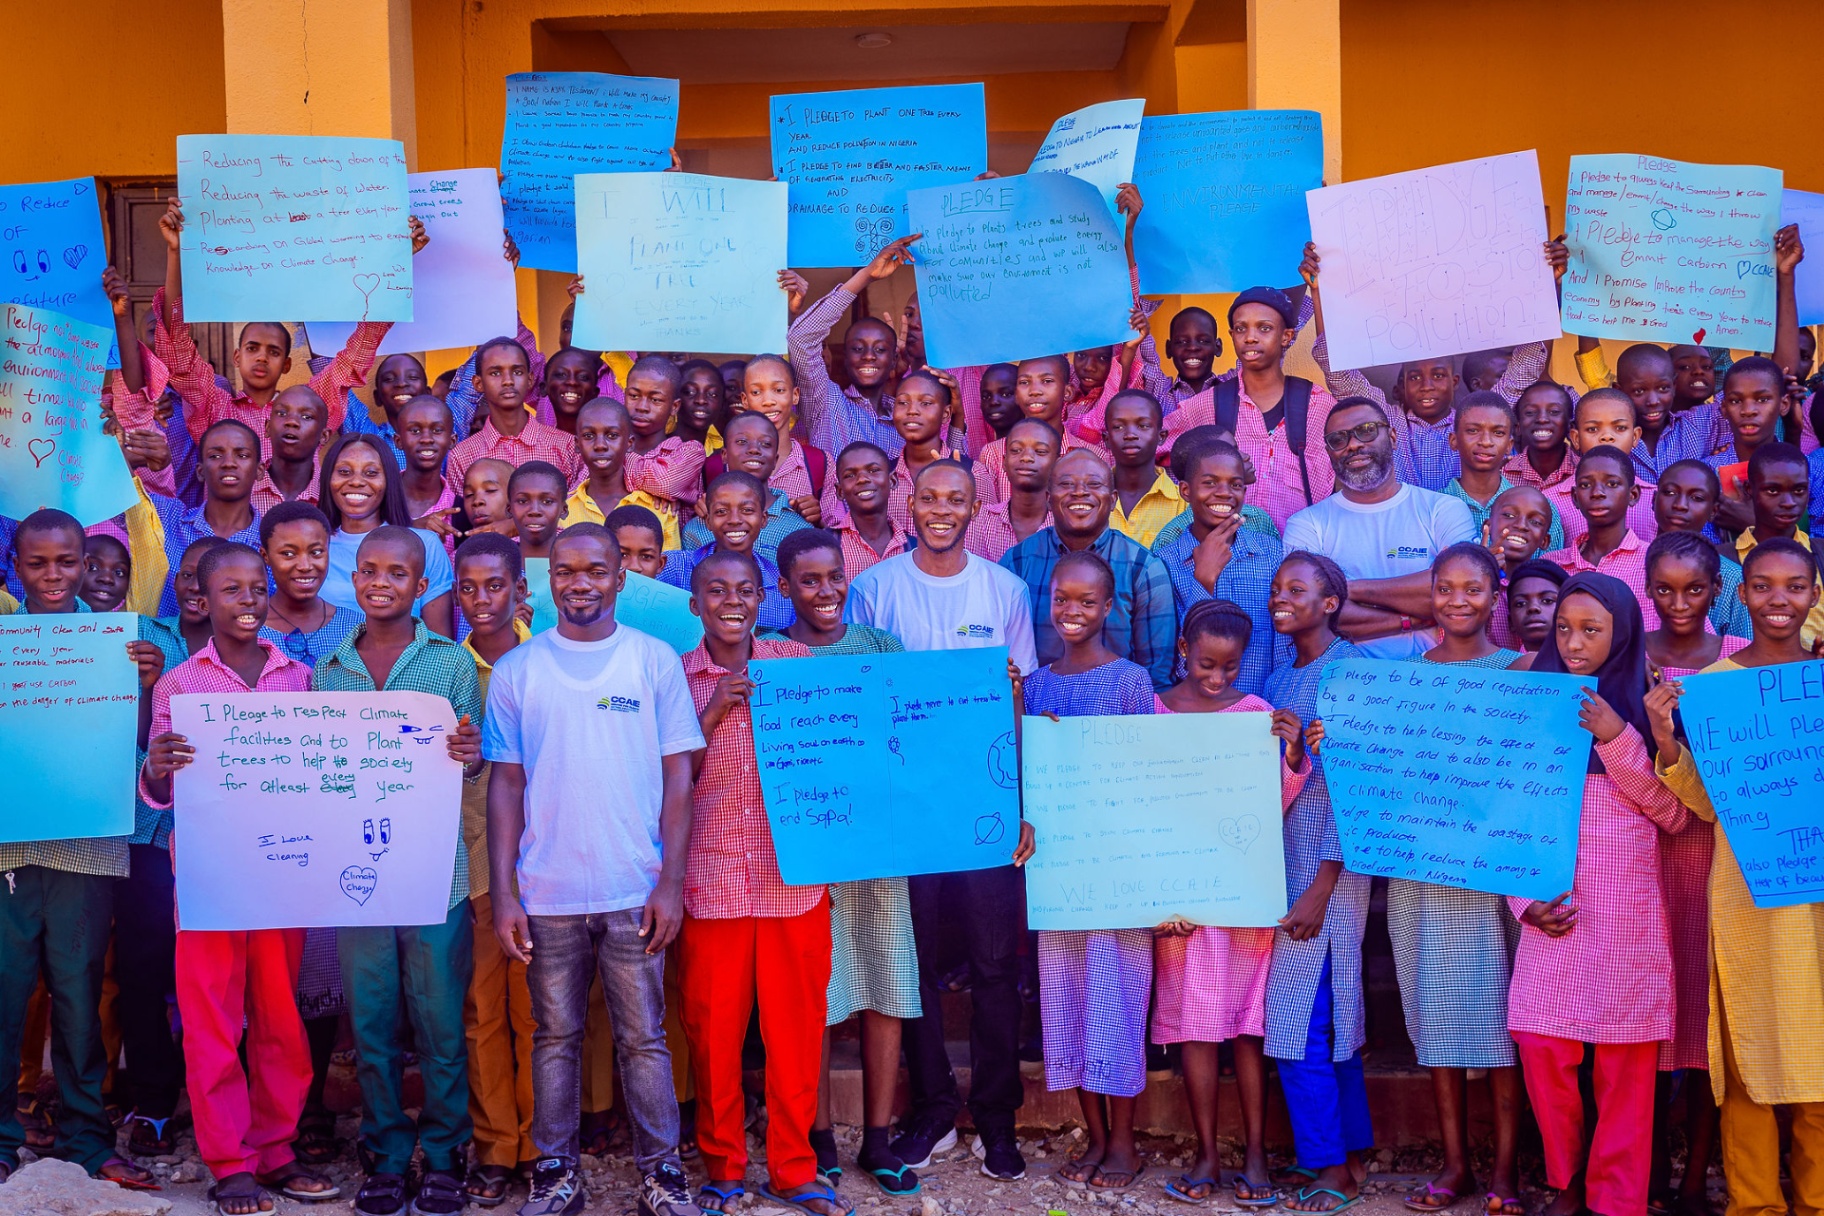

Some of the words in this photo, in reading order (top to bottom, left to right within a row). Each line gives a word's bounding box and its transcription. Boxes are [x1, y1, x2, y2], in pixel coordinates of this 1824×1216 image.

[784, 104, 796, 126] I
[841, 111, 854, 120] TO
[899, 109, 915, 117] ONE
[788, 146, 807, 154] AND
[203, 151, 262, 177] Reducing
[270, 154, 294, 167] the
[786, 159, 796, 173] I
[831, 162, 842, 170] TO
[789, 176, 800, 184] OF
[1613, 172, 1627, 182] to
[201, 178, 263, 210] Reducing
[269, 187, 290, 200] the
[827, 188, 849, 197] AND
[592, 191, 621, 219] I
[663, 187, 735, 214] WILL
[838, 205, 849, 213] TO
[941, 188, 1014, 214] PLEDGE
[263, 213, 287, 223] at
[1015, 220, 1041, 230] trees
[4, 226, 28, 240] OF
[1643, 231, 1662, 244] to
[1097, 242, 1118, 252] also
[1077, 259, 1091, 270] not
[1689, 282, 1704, 293] the
[22, 412, 31, 423] a
[1326, 666, 1340, 680] I
[1388, 670, 1402, 682] to
[1409, 671, 1422, 687] be
[1455, 678, 1486, 694] good
[1492, 682, 1560, 696] reputation
[753, 681, 773, 707] I
[814, 685, 829, 699] to
[835, 685, 862, 694] make
[1322, 687, 1337, 702] be
[1348, 694, 1355, 702] a
[1363, 696, 1394, 705] good
[200, 704, 215, 722] I
[271, 705, 285, 719] to
[890, 696, 900, 714] I
[759, 714, 780, 732] food
[791, 715, 824, 728] reach
[829, 714, 858, 728] every
[1383, 724, 1396, 734] to
[1402, 724, 1427, 737] help
[329, 734, 348, 749] to
[217, 751, 265, 767] trees
[271, 754, 291, 764] to
[1415, 751, 1439, 759] and
[1496, 756, 1511, 768] be
[1546, 764, 1563, 773] an
[220, 773, 247, 791] for
[1496, 777, 1514, 790] the
[1737, 777, 1798, 799] always
[773, 782, 791, 805] I
[832, 786, 848, 799] to
[1379, 810, 1392, 821] to
[1463, 820, 1477, 833] the
[258, 834, 276, 847] I
[1376, 846, 1391, 856] to
[1473, 856, 1488, 868] the
[1060, 882, 1096, 904] WE
[1113, 879, 1145, 898] LOVE
